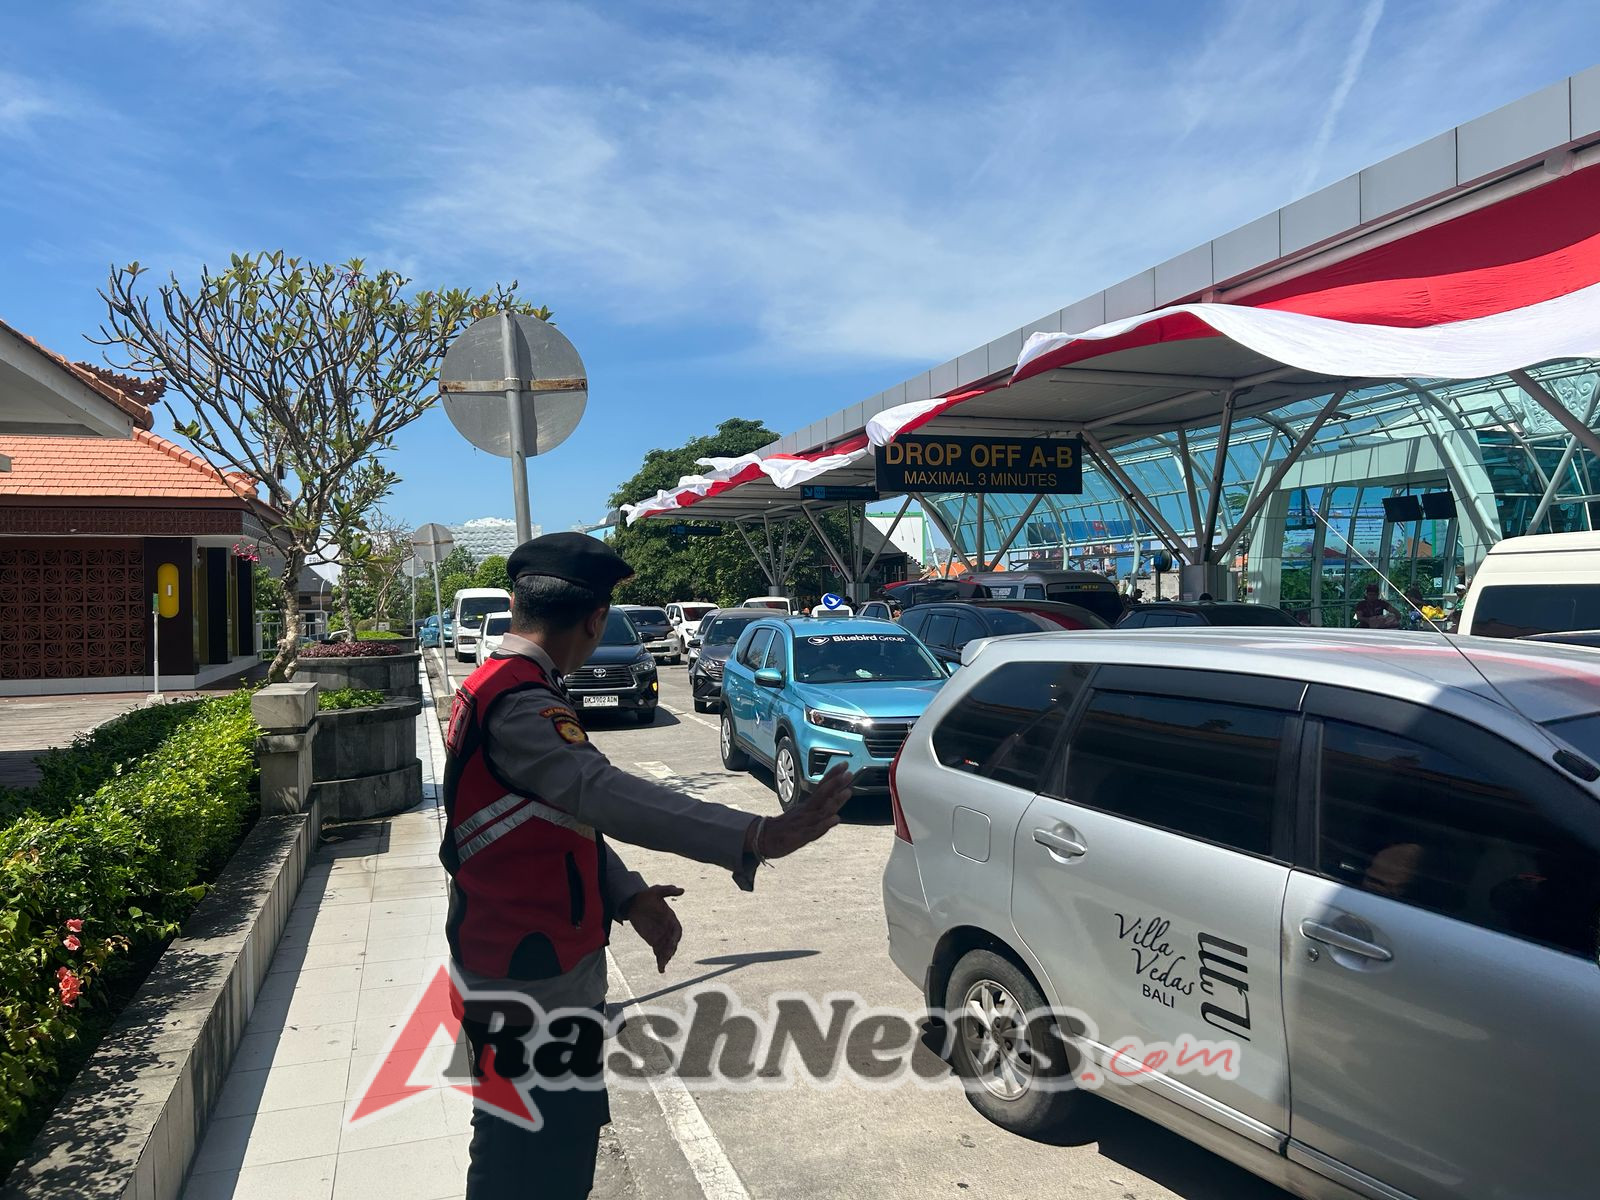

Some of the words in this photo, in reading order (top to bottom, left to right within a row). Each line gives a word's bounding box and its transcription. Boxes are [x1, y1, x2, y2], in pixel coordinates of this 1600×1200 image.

[885, 442, 962, 466] DROP
[970, 444, 1022, 468] OFF
[1029, 445, 1073, 469] A-B
[904, 470, 974, 486] MAXIMAL
[978, 472, 986, 486] 3
[991, 472, 1057, 487] MINUTES
[832, 634, 878, 642] Bluebird
[1114, 913, 1174, 957] Villa
[1131, 948, 1195, 996] Vedas
[1142, 983, 1176, 1009] BALI
